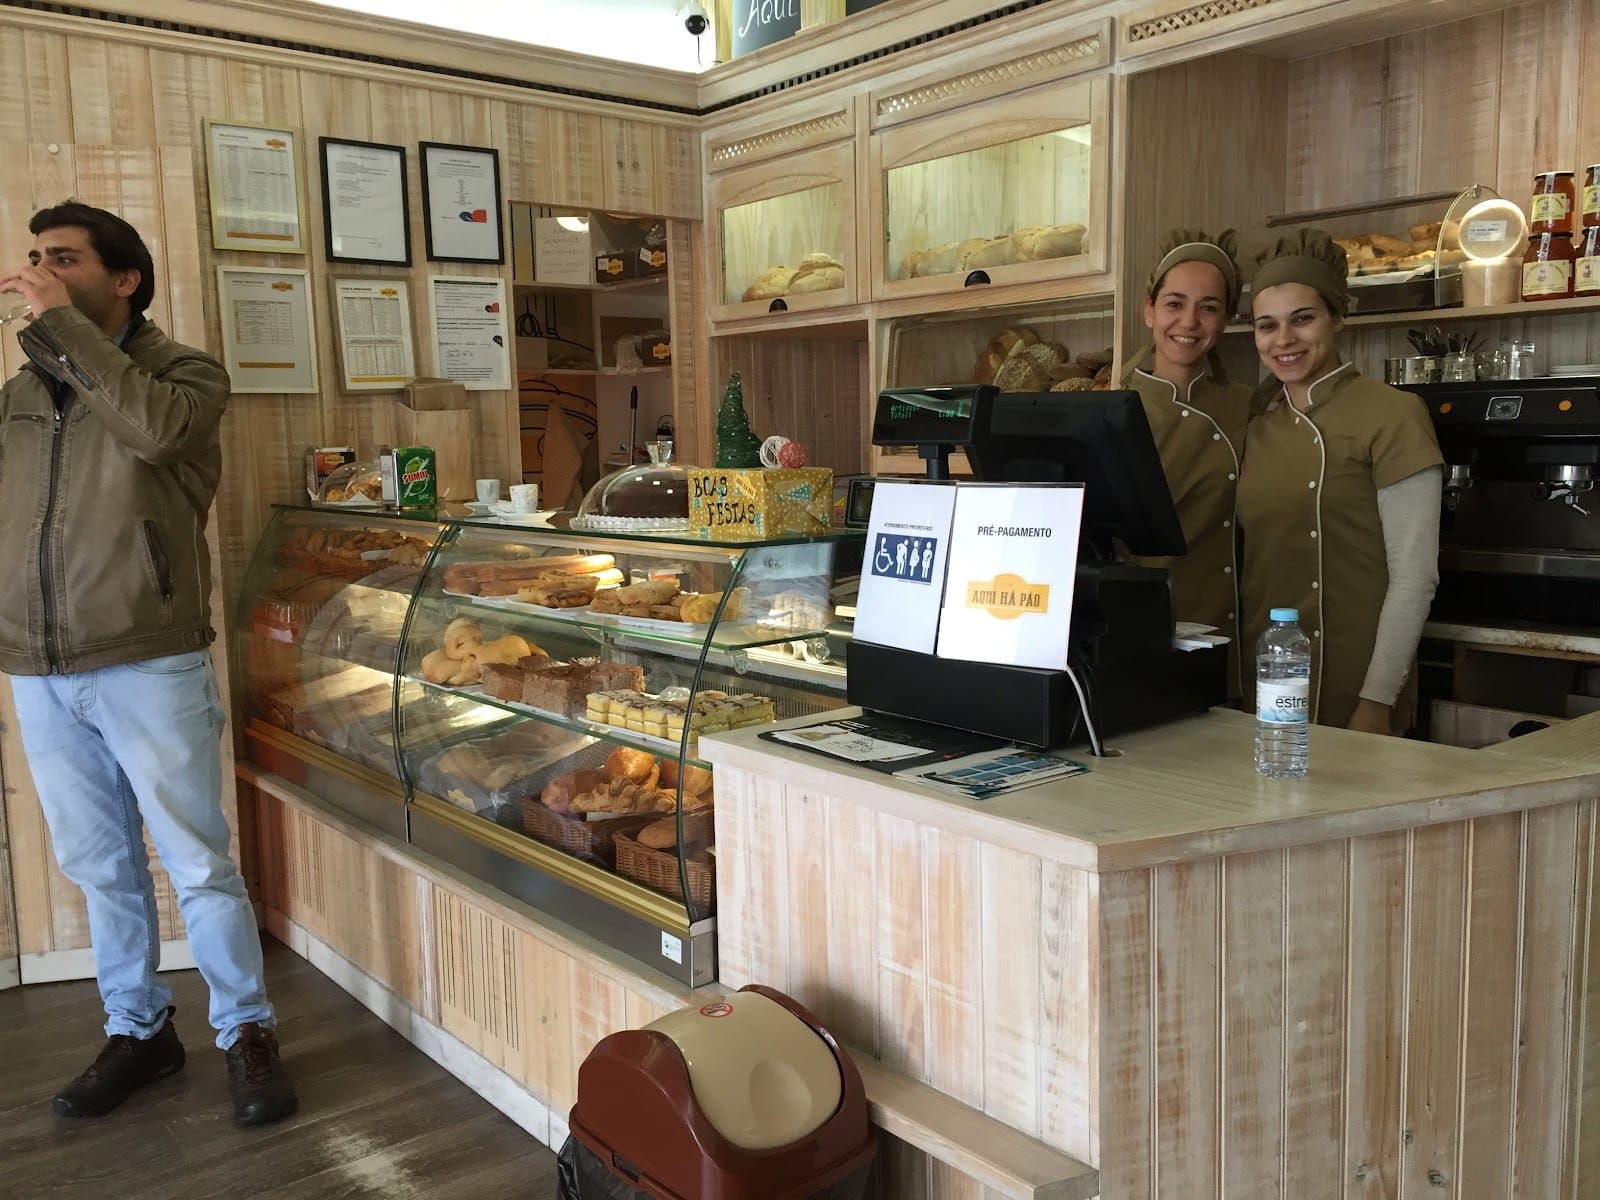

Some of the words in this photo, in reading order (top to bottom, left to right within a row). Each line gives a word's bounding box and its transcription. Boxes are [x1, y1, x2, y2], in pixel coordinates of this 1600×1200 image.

[707, 503, 756, 526] FESTAS
[977, 524, 1052, 538] PRÉ-PAGAMENTO
[971, 589, 996, 605] AQUI
[1000, 588, 1016, 606] HÁ
